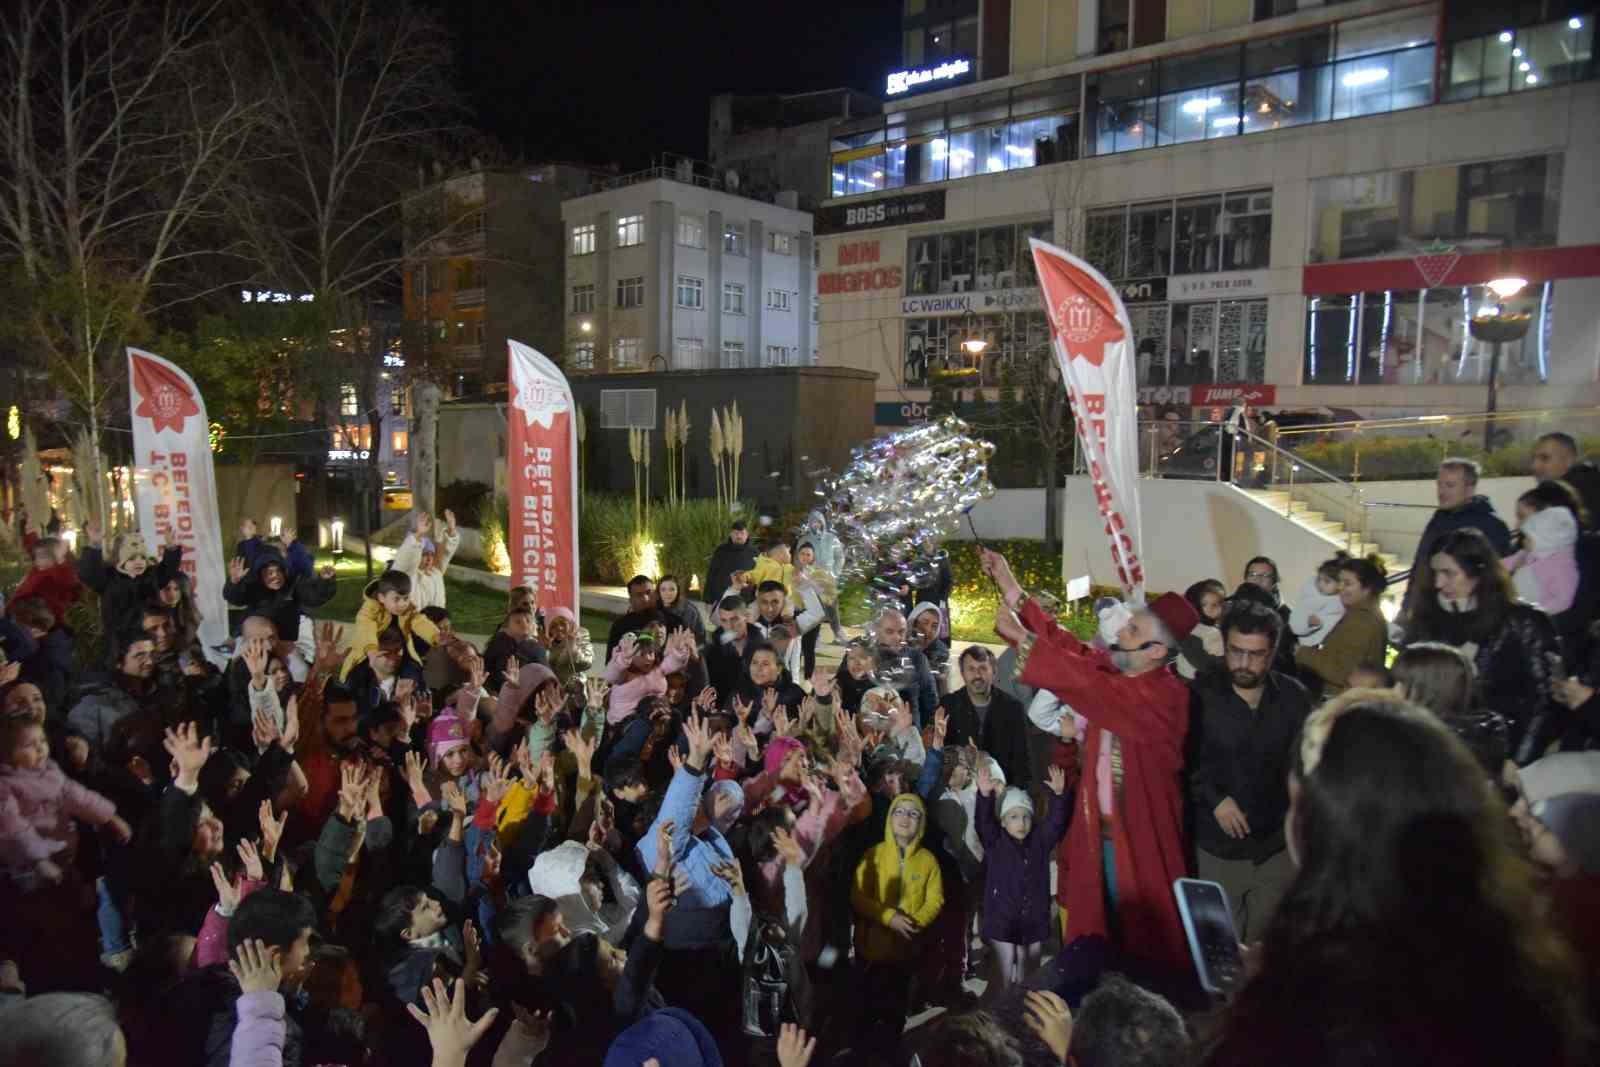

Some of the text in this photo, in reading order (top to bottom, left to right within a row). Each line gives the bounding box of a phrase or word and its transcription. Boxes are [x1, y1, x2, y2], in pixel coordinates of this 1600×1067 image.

[846, 203, 886, 225] BOSS
[818, 266, 902, 294] MIGROS
[902, 300, 919, 313] LC
